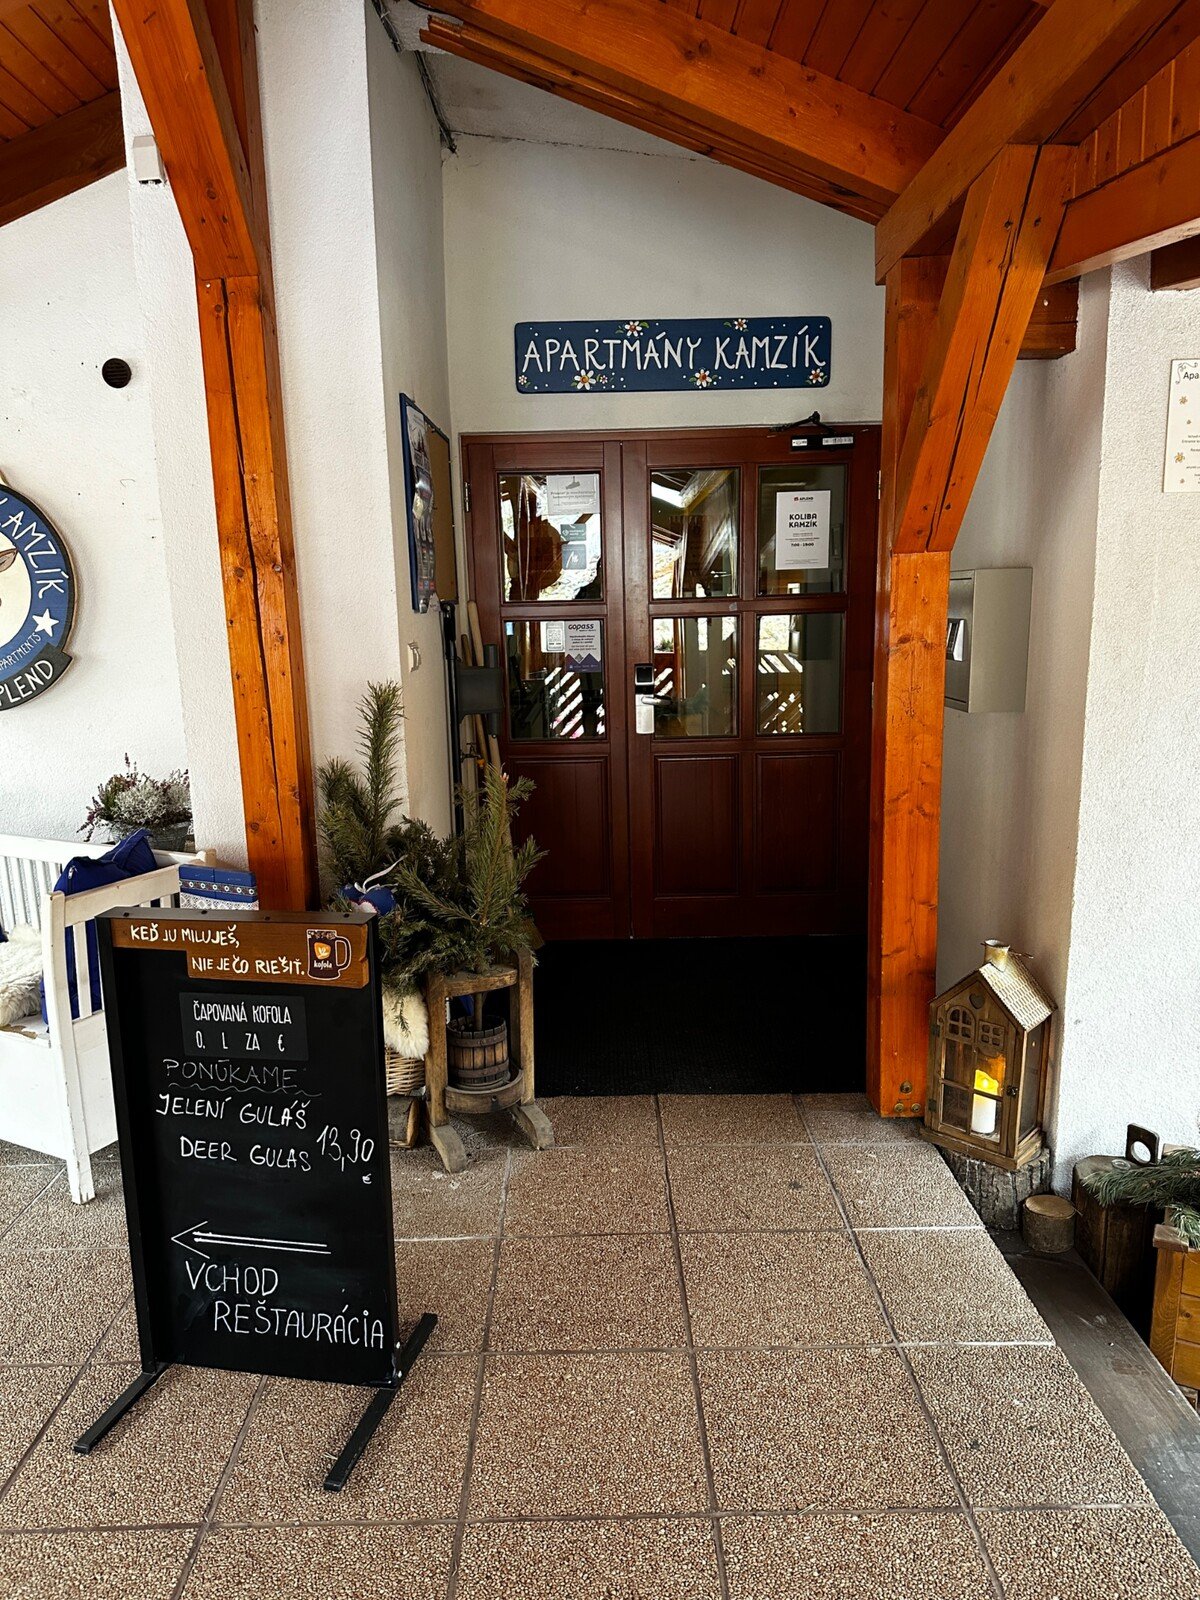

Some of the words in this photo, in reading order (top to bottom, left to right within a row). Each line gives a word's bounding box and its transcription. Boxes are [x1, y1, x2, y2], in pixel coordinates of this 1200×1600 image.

[522, 332, 702, 373] APARTMÁNY
[714, 325, 826, 370] KAMZÍK
[788, 520, 817, 528] KAMZÍK
[0, 497, 69, 600] AMZÍK
[130, 923, 159, 942] KEĎ
[162, 928, 177, 943] JU
[181, 924, 241, 949] MILUJEŠ,
[191, 956, 214, 972] NIE
[216, 957, 231, 972] JE
[231, 954, 250, 975] ČO
[255, 956, 306, 976] RIEŠIŤ.
[313, 958, 333, 971] kofola
[193, 1000, 248, 1023] ČAPOVANÁ
[252, 1005, 292, 1025] KOFOLA
[195, 1030, 206, 1050] 0.
[221, 1032, 229, 1050] L
[245, 1032, 261, 1052] ZA
[277, 1034, 286, 1052] €
[155, 1093, 232, 1119] JELENÍ
[239, 1099, 312, 1130] GULÁŠ
[179, 1135, 238, 1162] DEER
[249, 1144, 312, 1172] GULAS
[316, 1124, 375, 1173] 13,90
[362, 1173, 373, 1185] €
[185, 1260, 279, 1297] VCHOD
